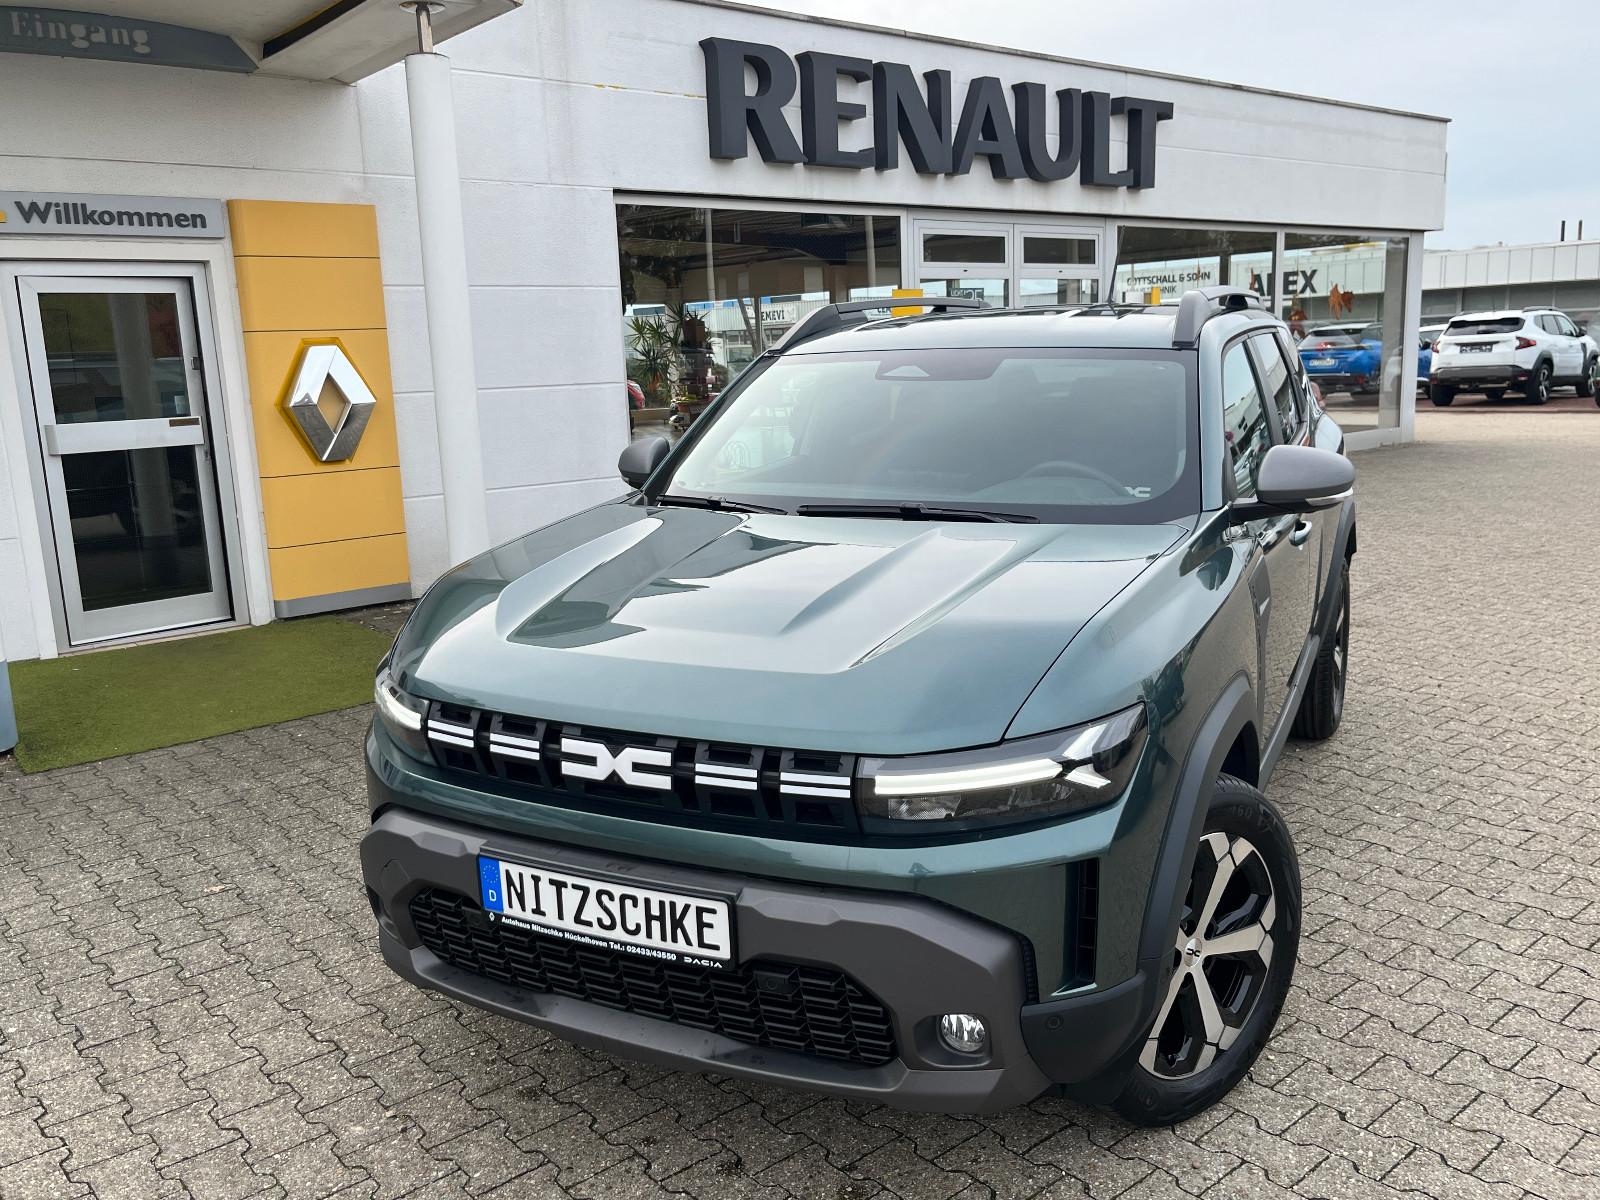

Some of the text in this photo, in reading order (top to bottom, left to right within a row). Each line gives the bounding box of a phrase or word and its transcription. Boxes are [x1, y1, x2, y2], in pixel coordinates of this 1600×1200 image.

[10, 11, 151, 54] Eingang
[699, 37, 1174, 190] RENAULT
[14, 200, 207, 228] Willkommen
[488, 868, 721, 952] D NITZSCHKE
[502, 916, 531, 930] Autohaus
[531, 923, 564, 938] Nitzschke
[564, 931, 608, 948] Hückelhoven
[626, 945, 677, 961] 02433/43550
